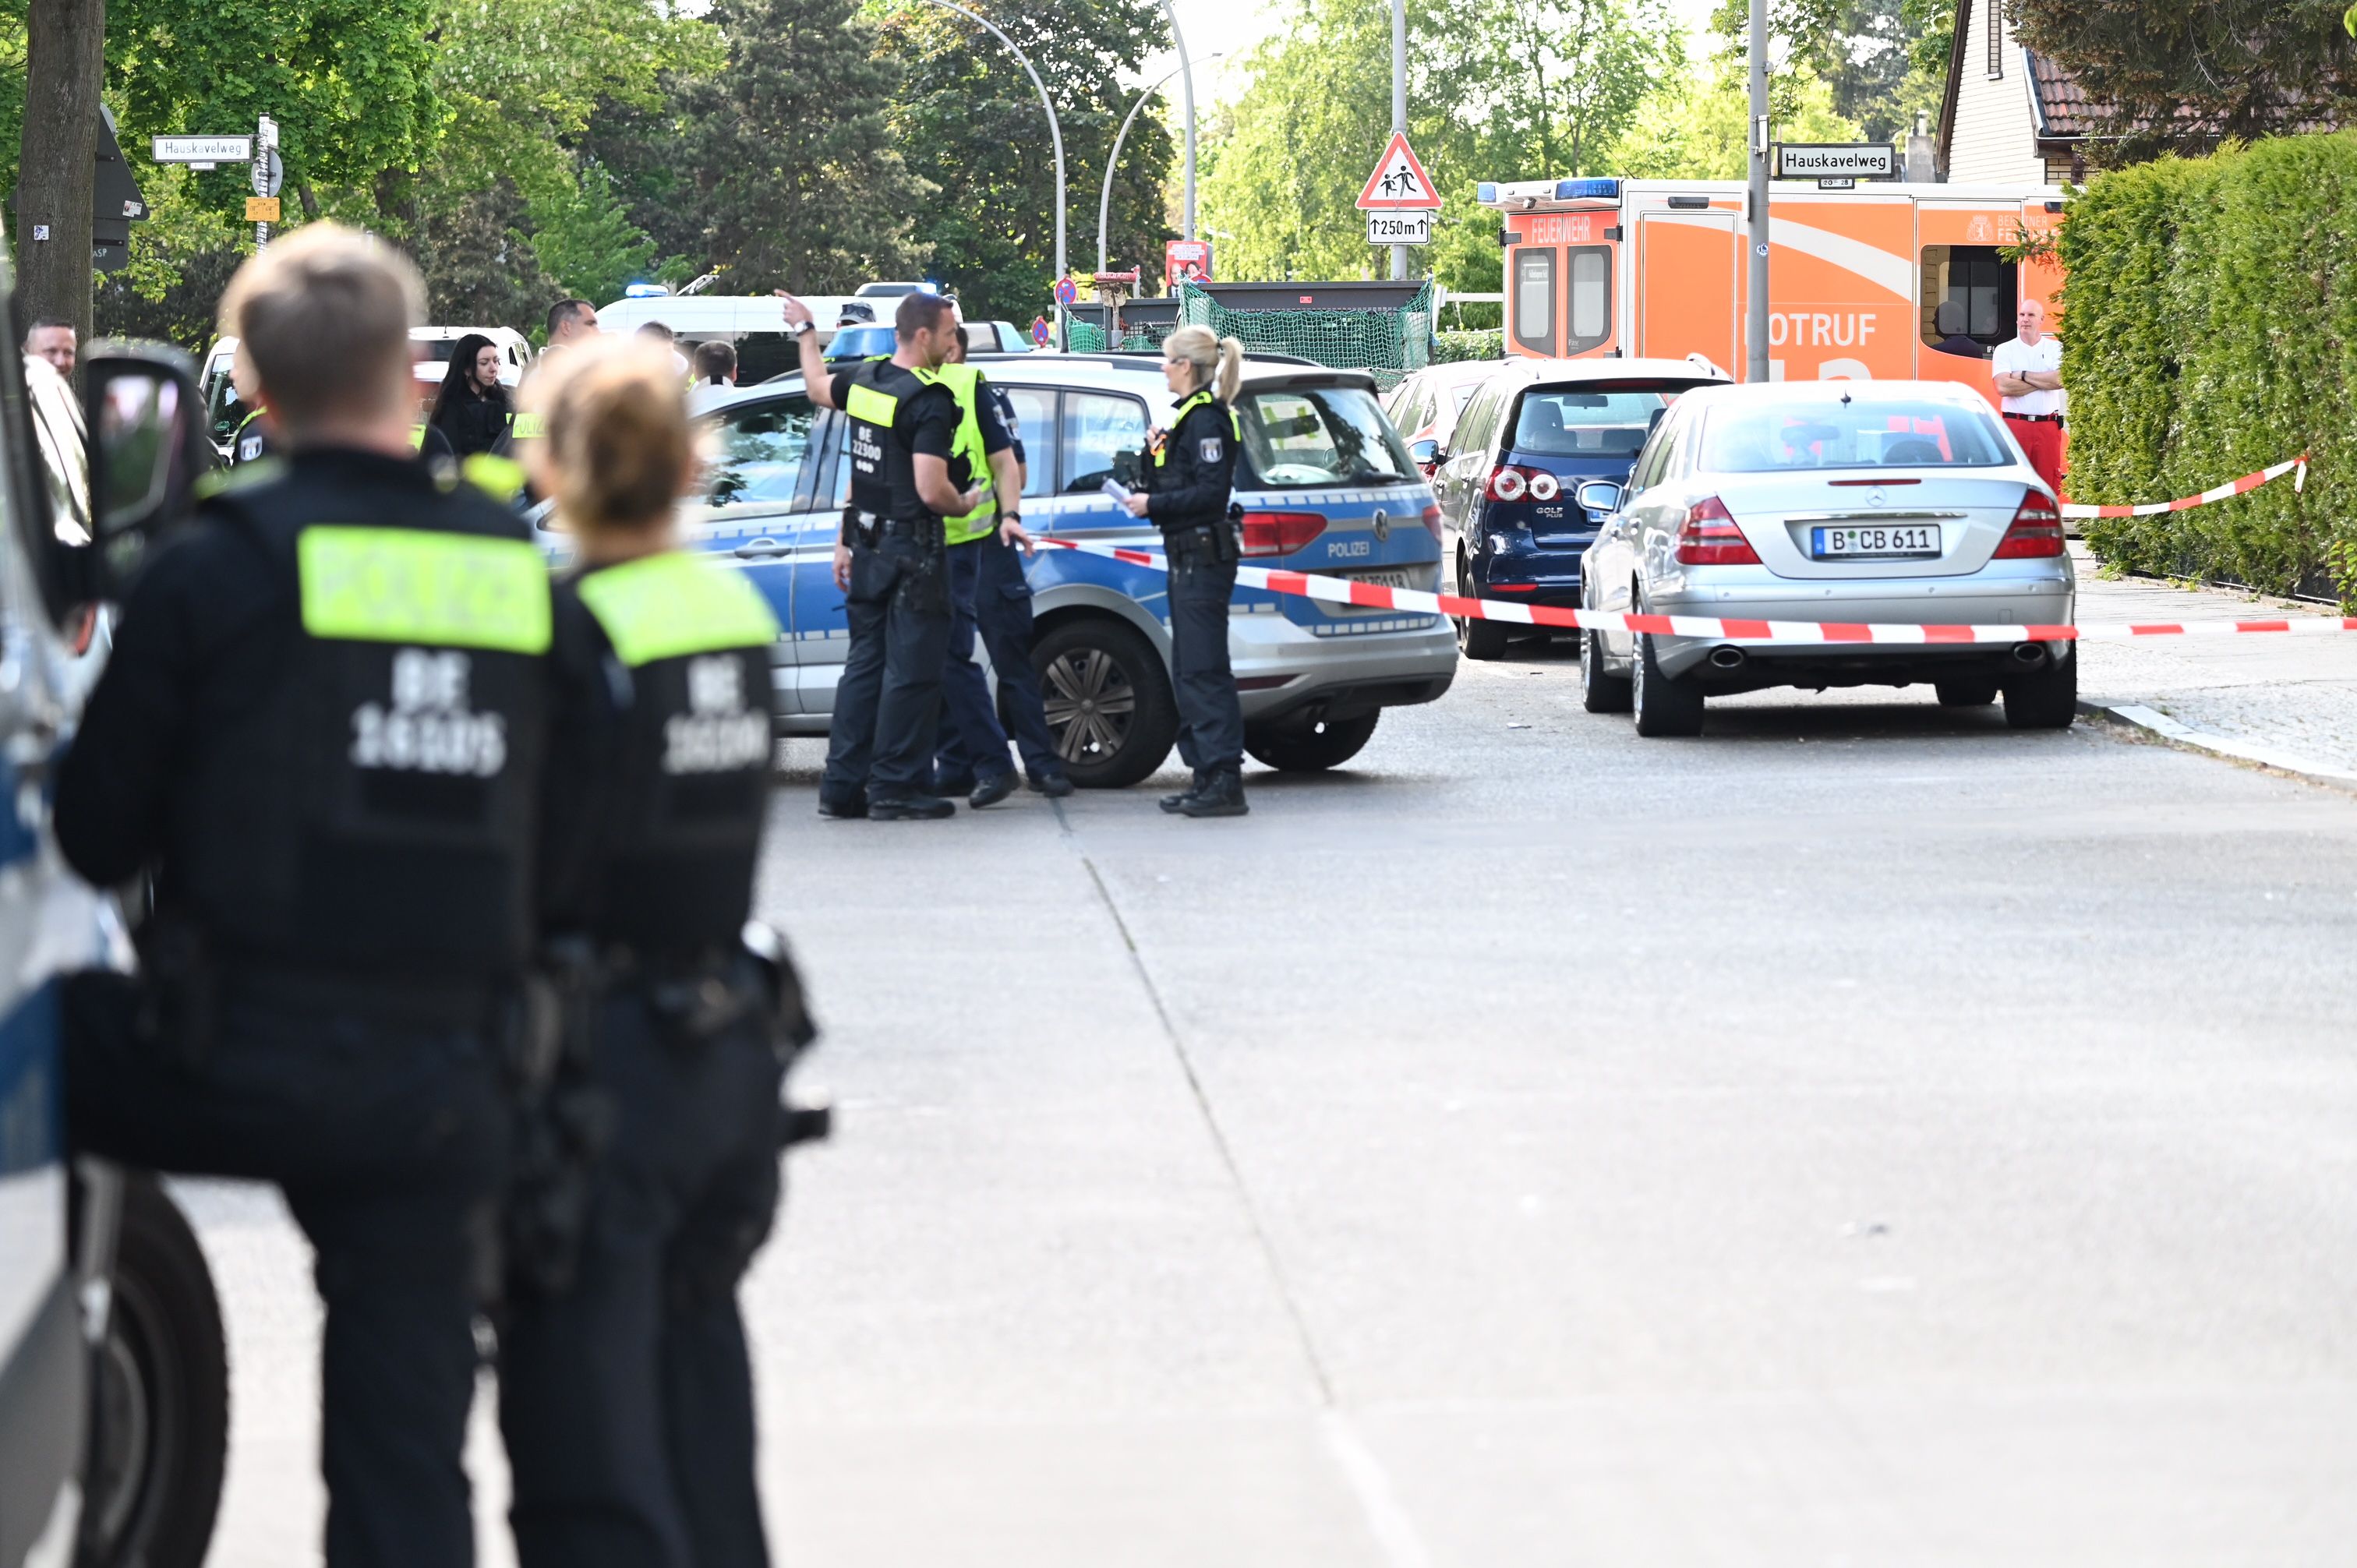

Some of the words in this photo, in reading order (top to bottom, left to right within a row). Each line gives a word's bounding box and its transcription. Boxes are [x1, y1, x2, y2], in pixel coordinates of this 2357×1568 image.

[164, 142, 242, 156] Hauskavelweg
[1786, 153, 1886, 170] Hauskavelweg
[1532, 215, 1591, 244] FEUERWEHR
[1998, 215, 2048, 227] BERINER
[1744, 313, 1876, 347] OTRUF
[858, 426, 872, 443] BE
[853, 440, 882, 461] 22300
[1832, 531, 1845, 550] B
[1861, 531, 1886, 549] CB
[1892, 530, 1930, 549] 611
[1327, 541, 1370, 558] POLIZEI
